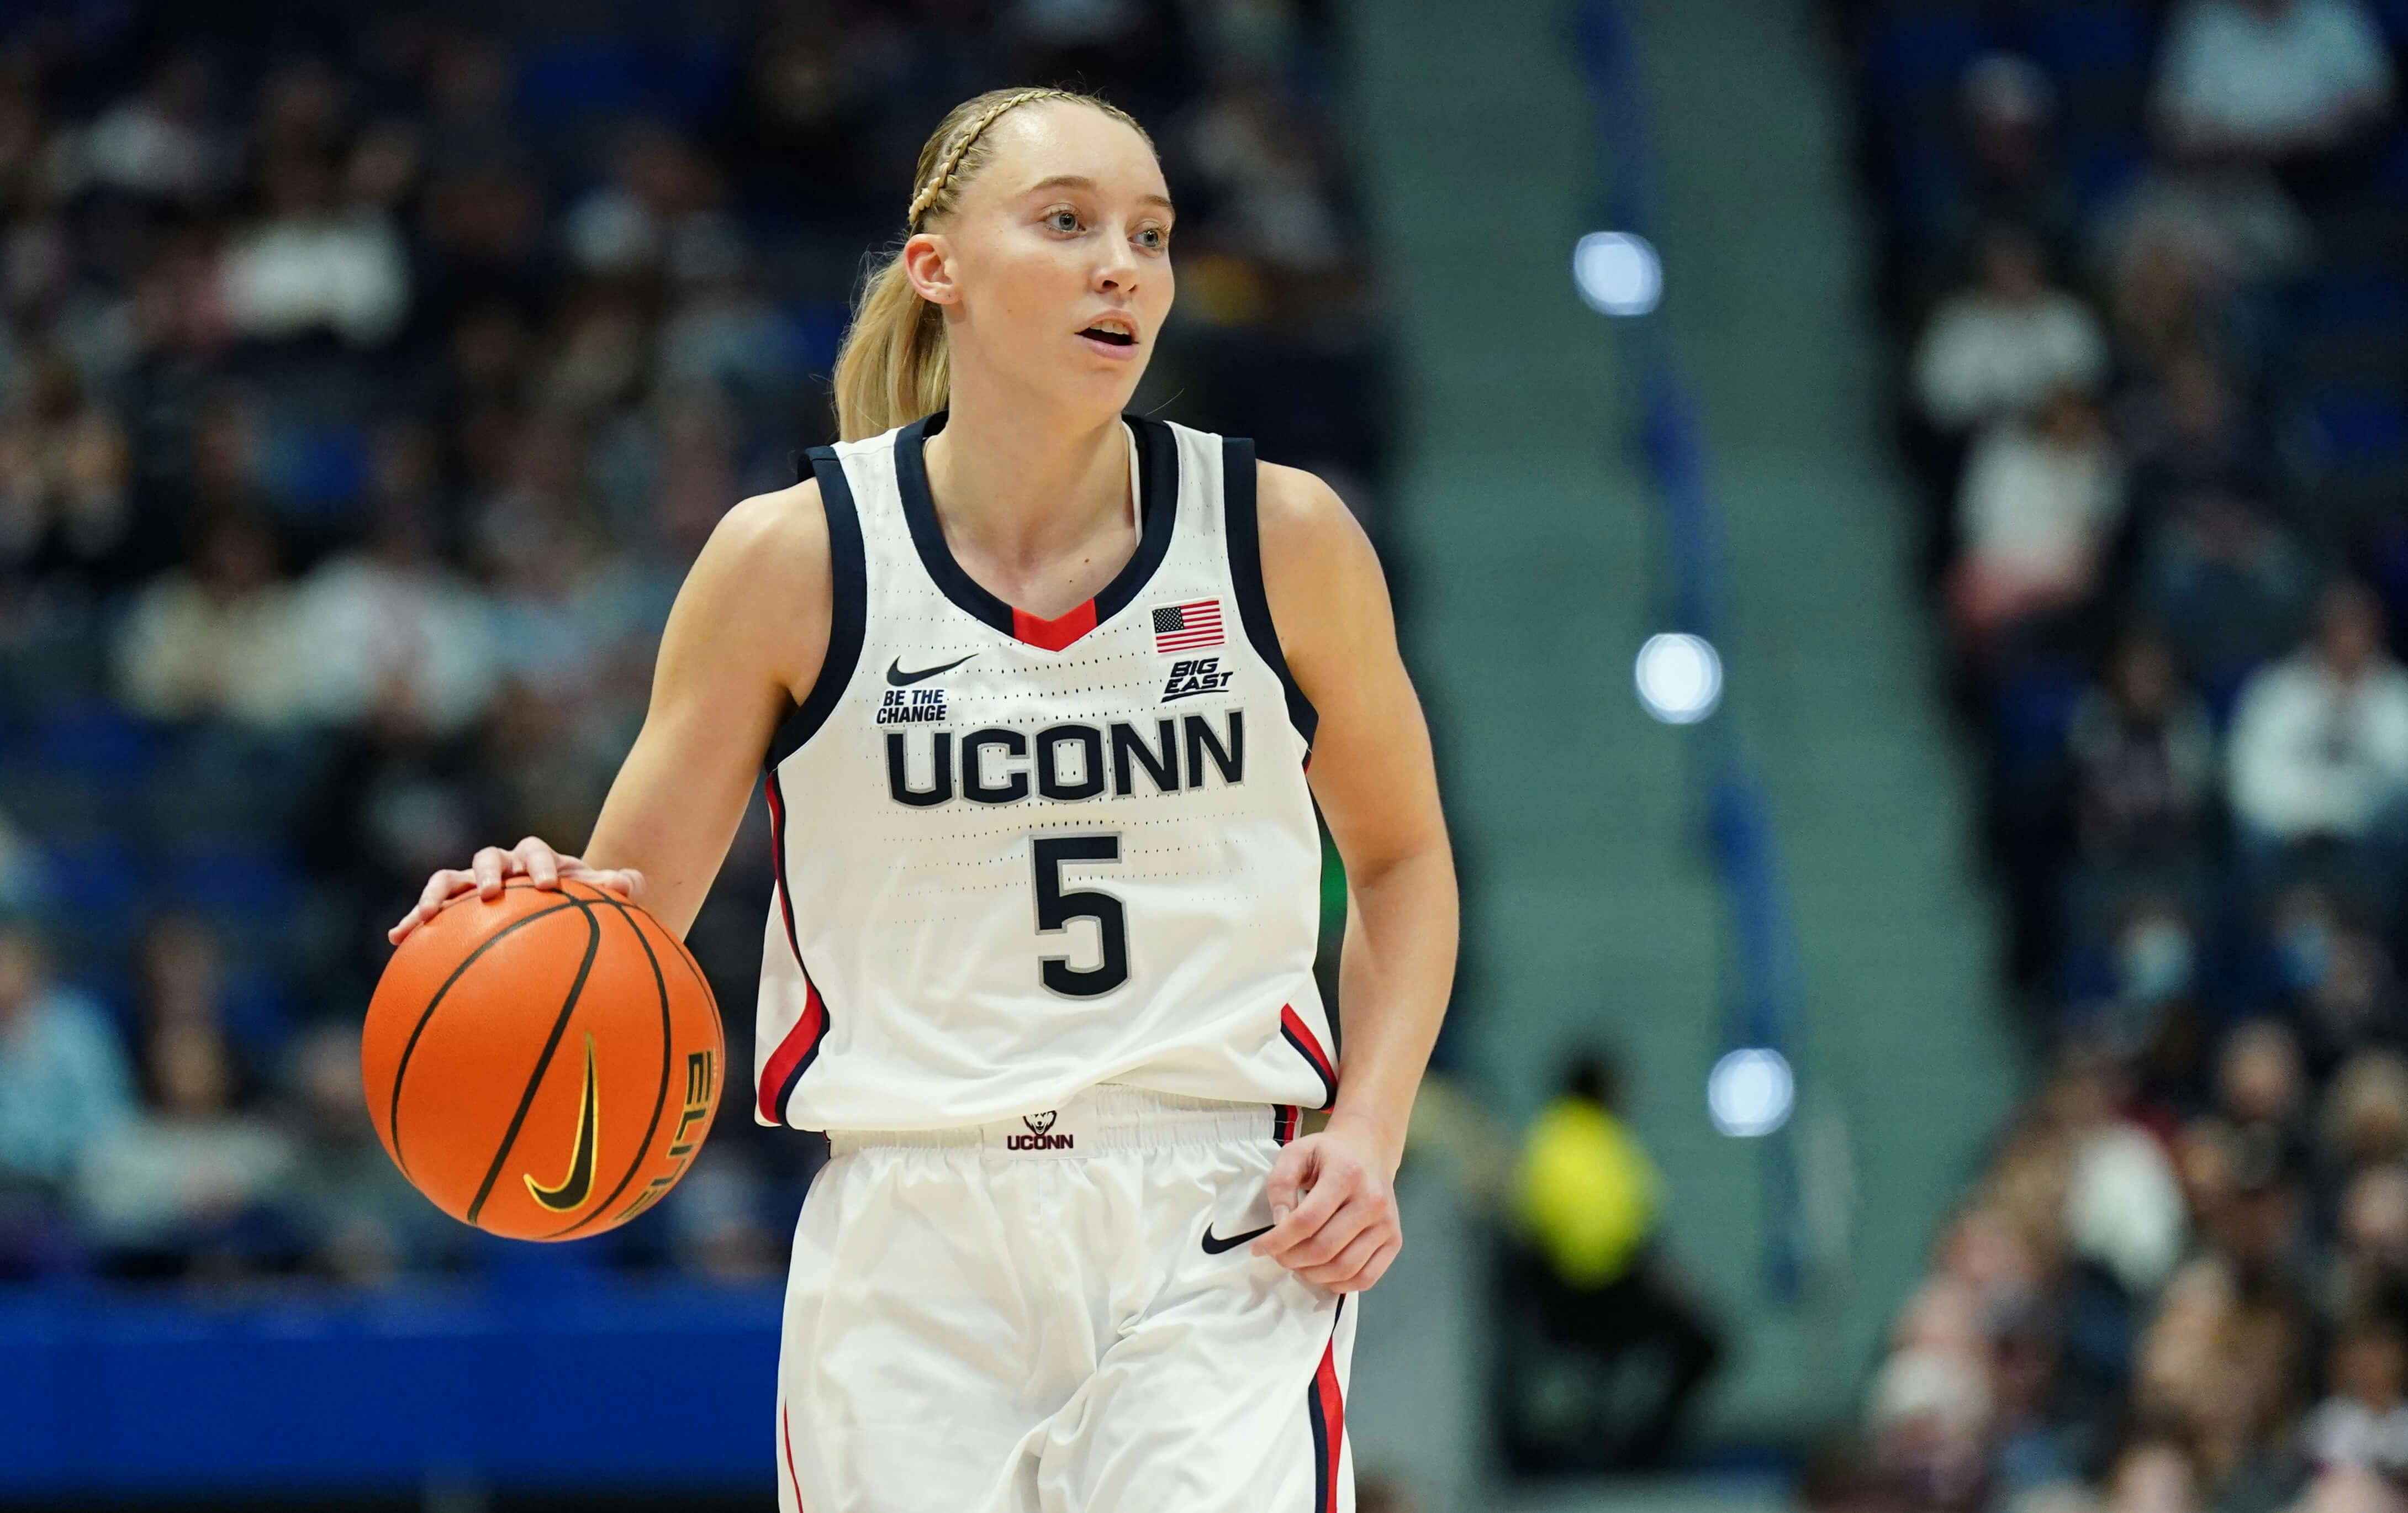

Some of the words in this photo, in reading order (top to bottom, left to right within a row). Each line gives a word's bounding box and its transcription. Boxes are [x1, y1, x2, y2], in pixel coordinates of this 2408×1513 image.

[1170, 657, 1219, 677] BIG
[1164, 671, 1233, 694] EAST
[883, 690, 906, 706] BE
[912, 689, 944, 705] THE
[876, 705, 947, 724] CHANGE
[884, 707, 1246, 810] UCONN
[1028, 831, 1132, 1001] 5
[1007, 1134, 1074, 1151] UCONN
